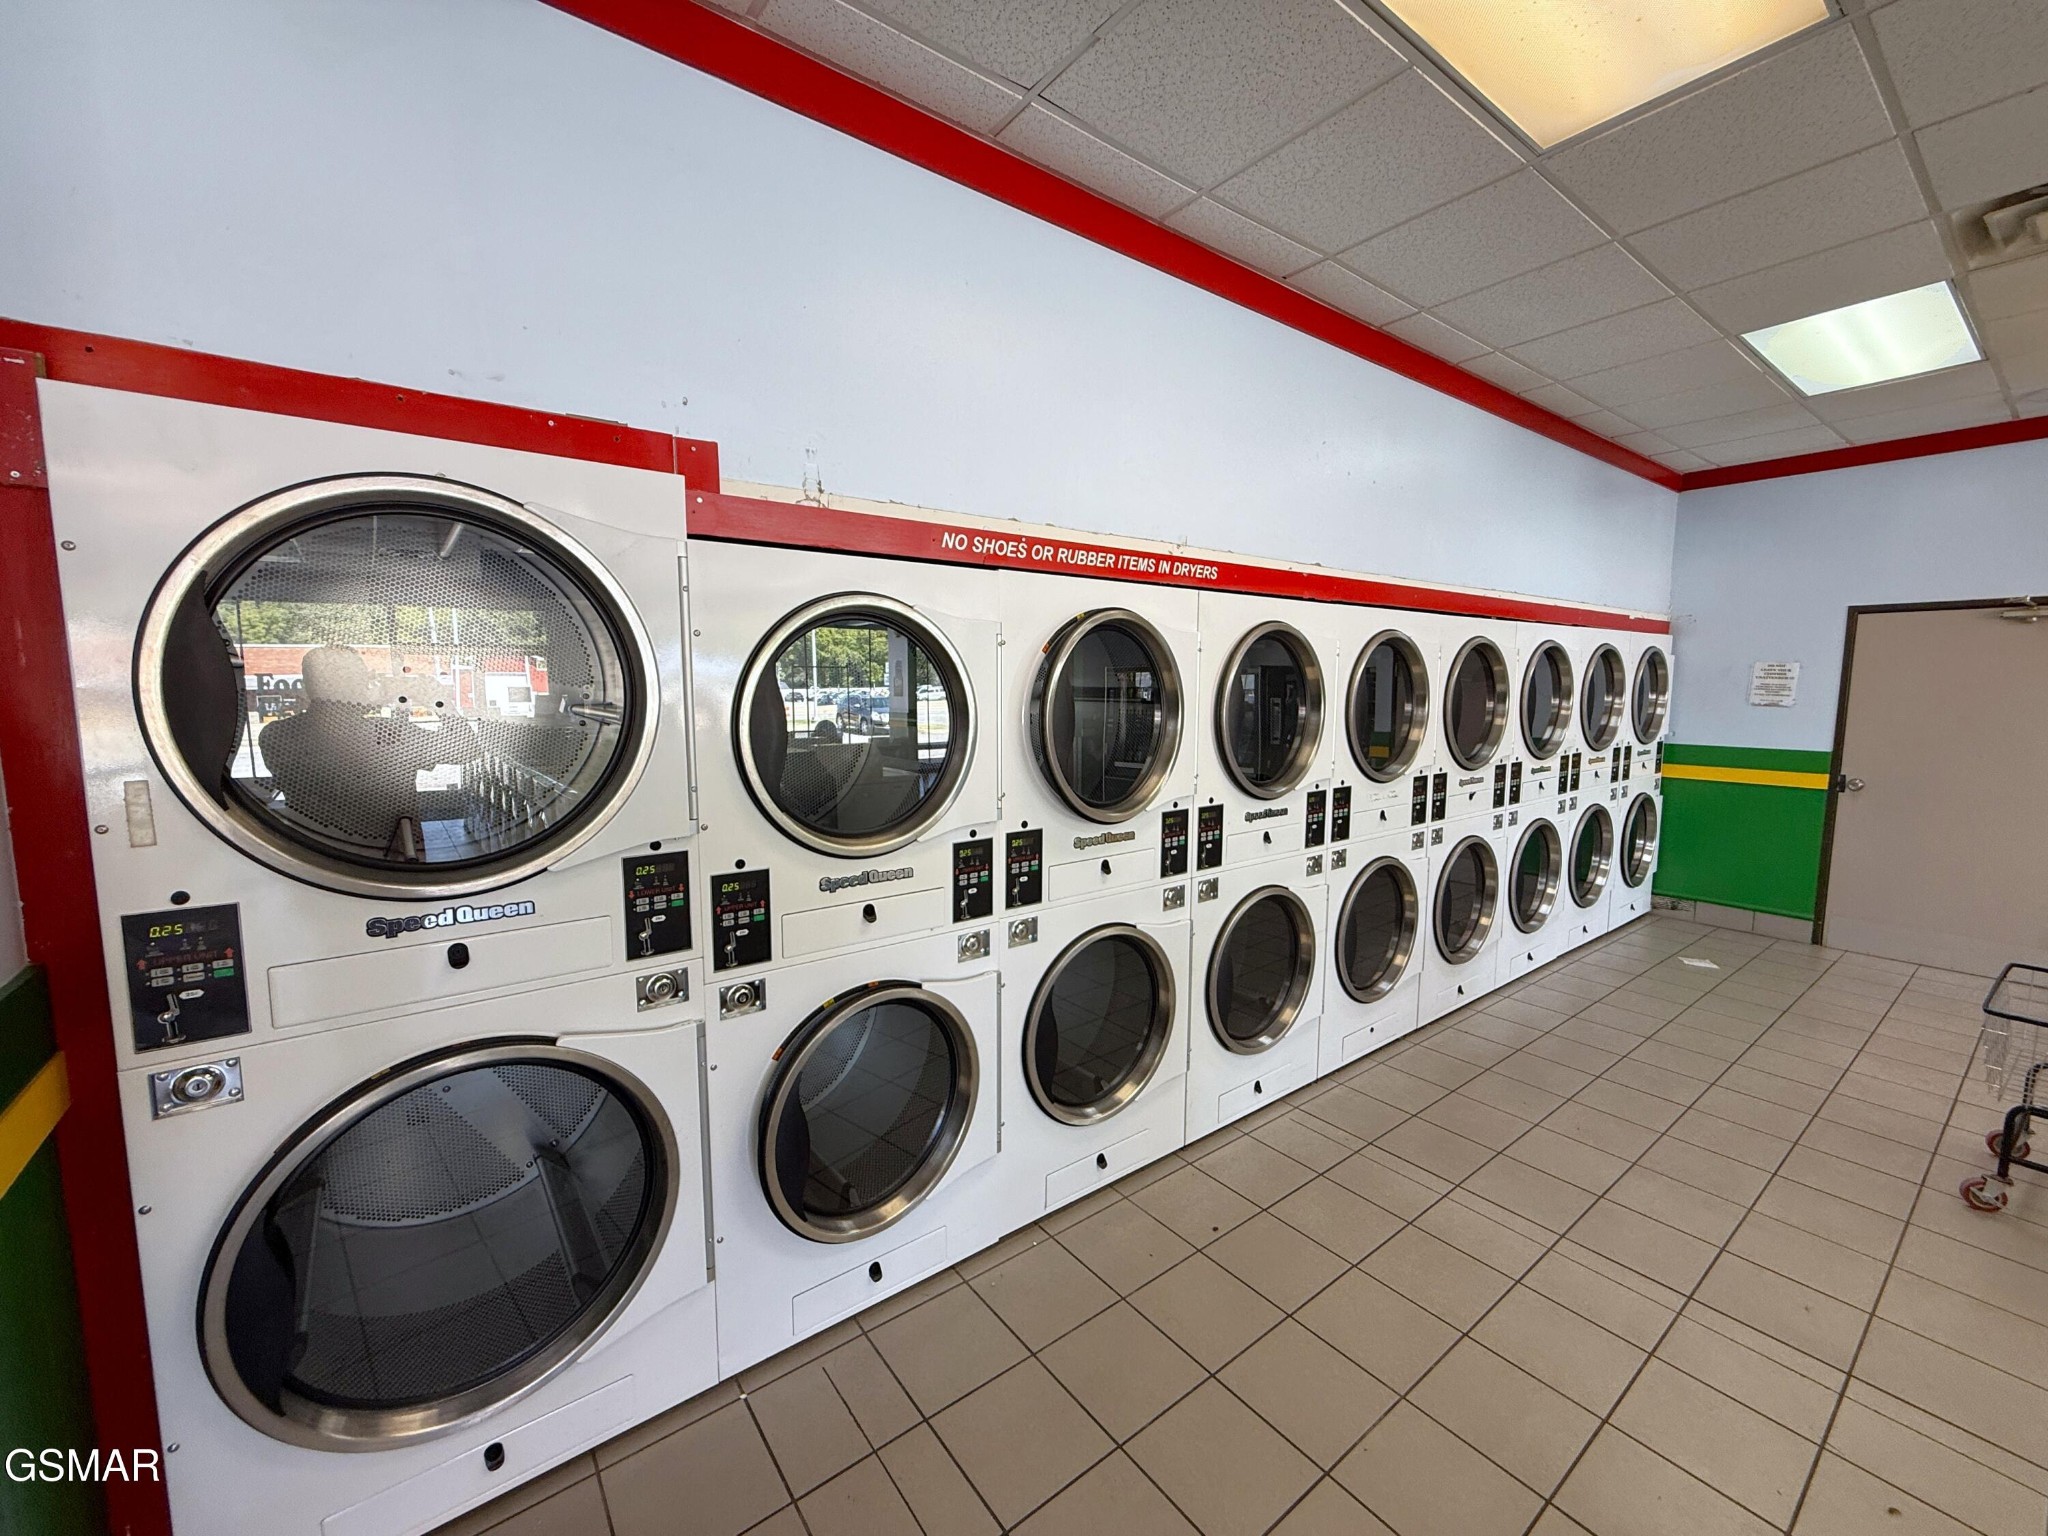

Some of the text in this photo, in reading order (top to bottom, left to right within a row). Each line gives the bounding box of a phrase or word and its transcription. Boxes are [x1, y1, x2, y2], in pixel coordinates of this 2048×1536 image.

[941, 531, 1218, 580] NO SHOES OR RUBBER ITEMS IN DRYERS
[255, 673, 304, 694] Foo
[149, 923, 184, 938] 0.25
